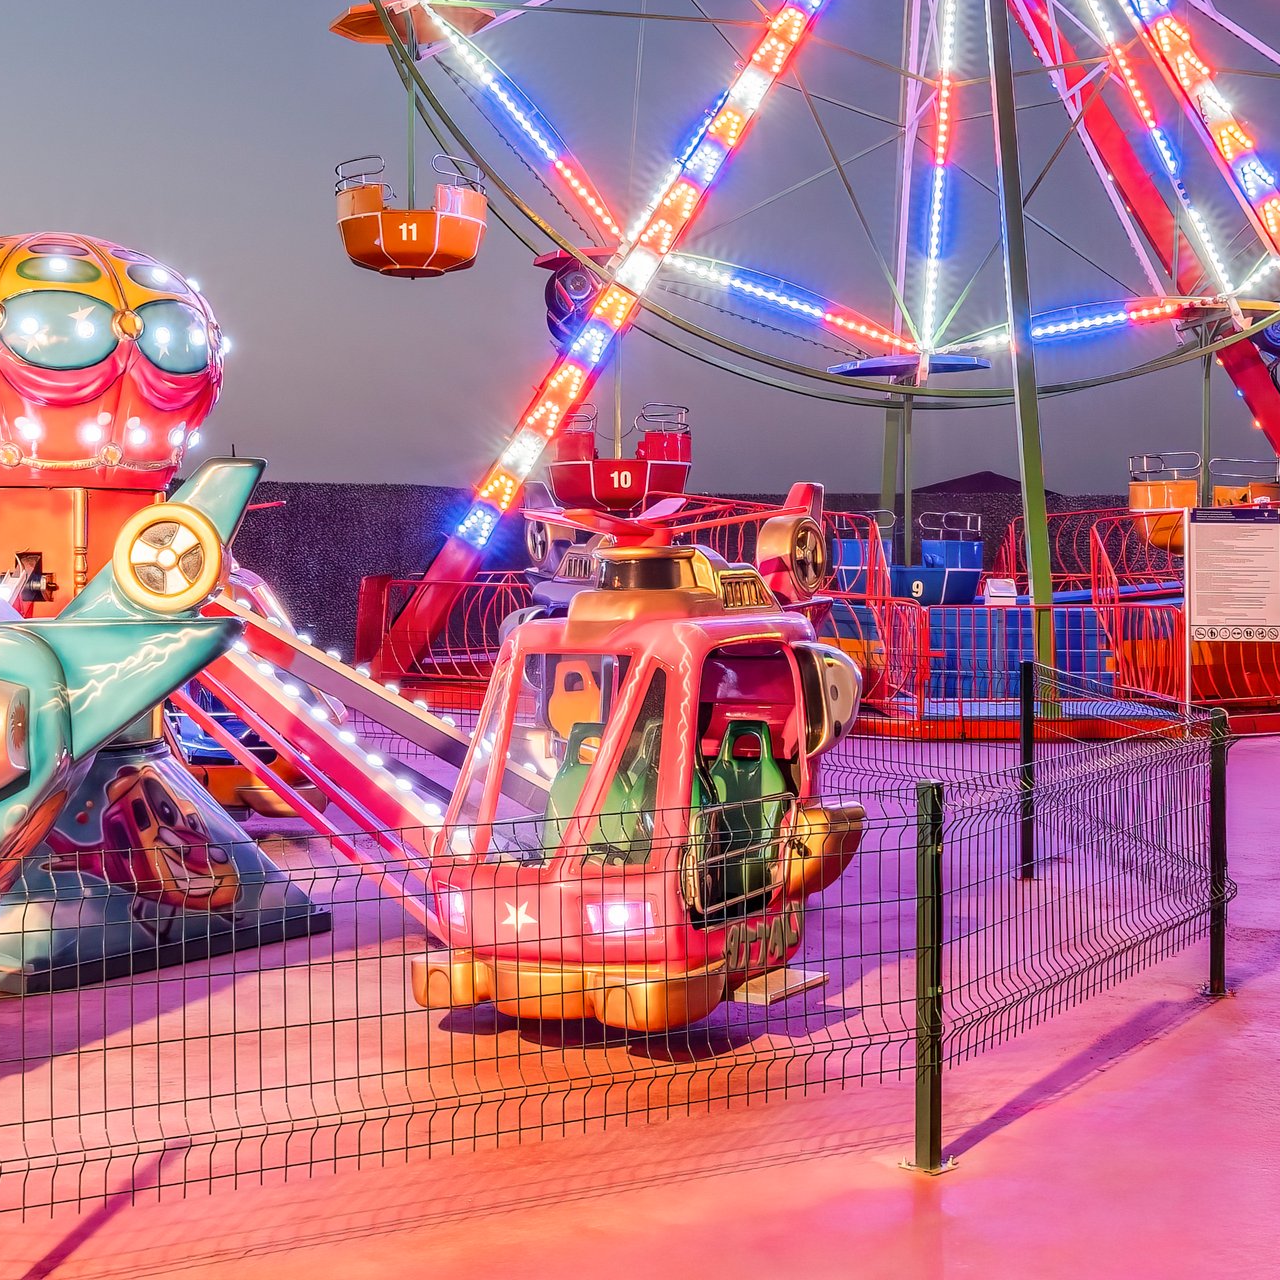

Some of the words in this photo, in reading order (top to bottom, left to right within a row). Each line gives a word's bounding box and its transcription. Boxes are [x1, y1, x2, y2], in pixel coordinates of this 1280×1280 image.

[398, 222, 417, 241] 11
[610, 470, 632, 489] 10
[912, 580, 924, 598] 9
